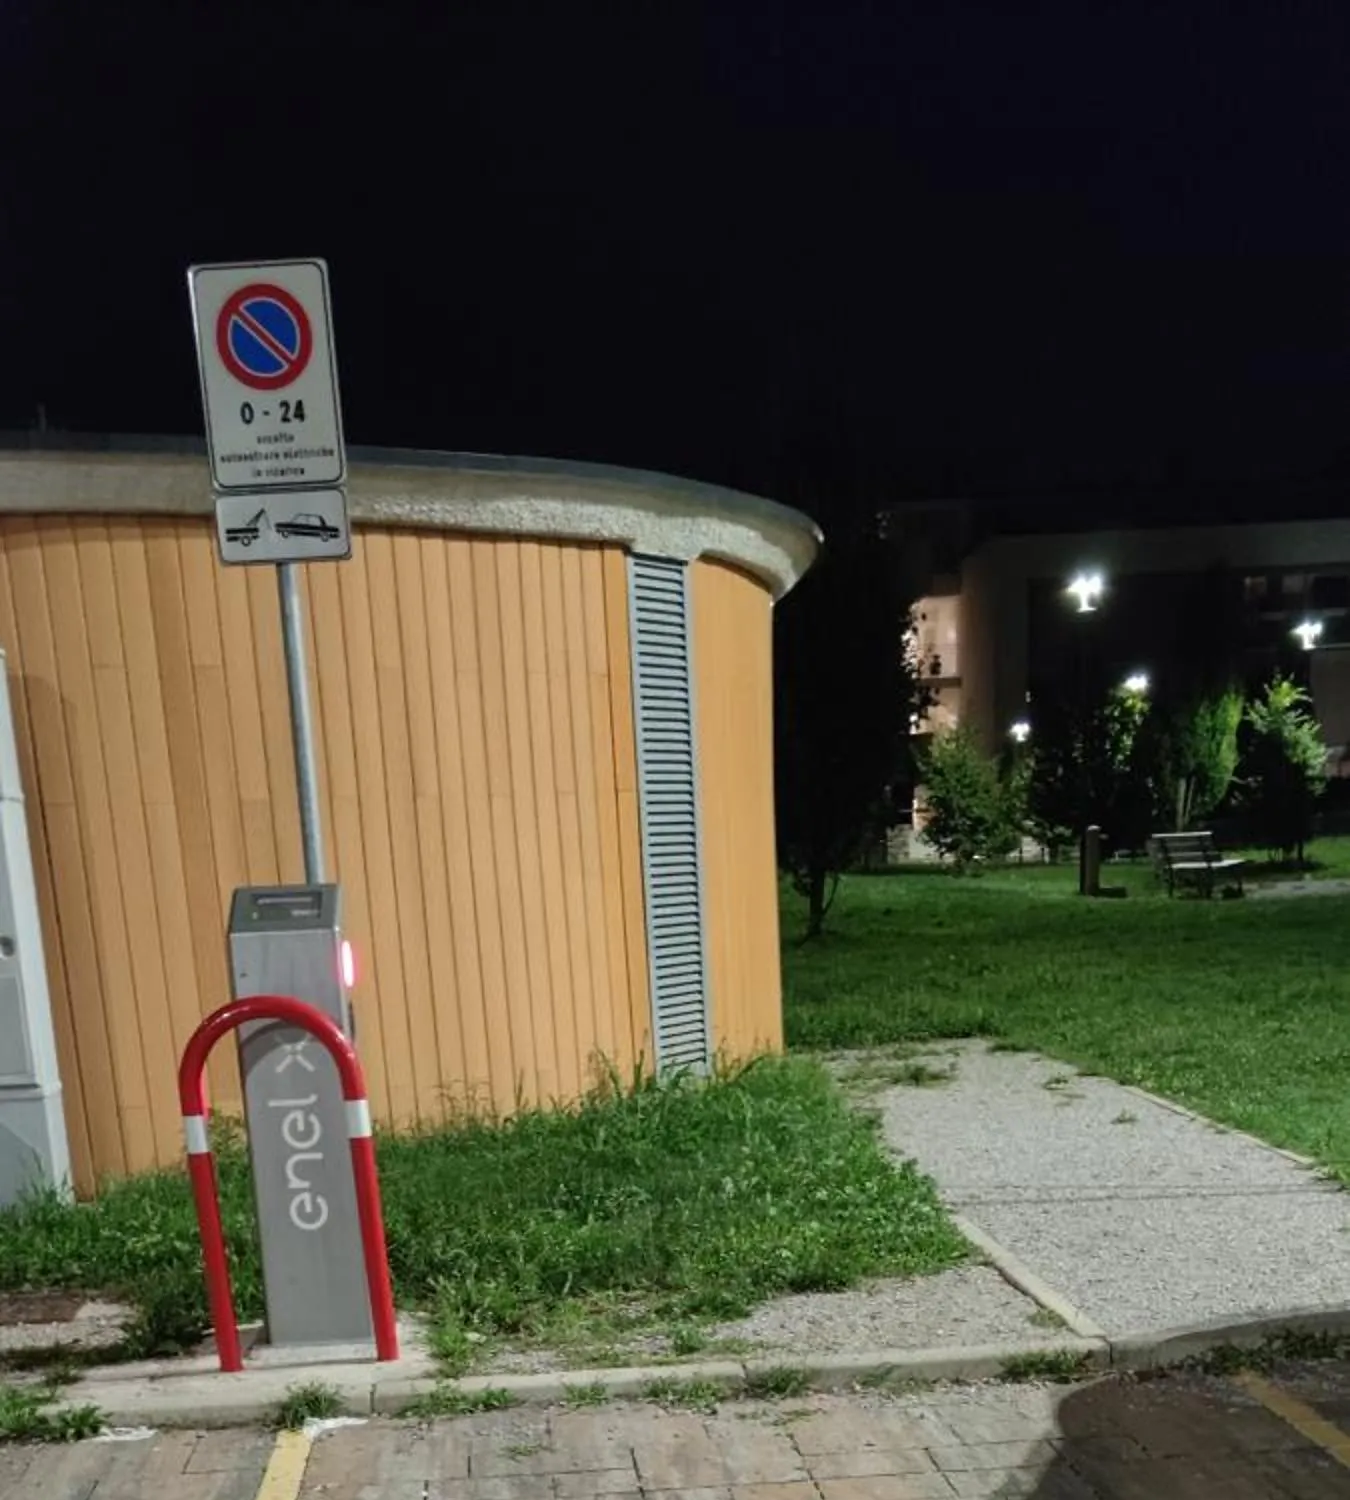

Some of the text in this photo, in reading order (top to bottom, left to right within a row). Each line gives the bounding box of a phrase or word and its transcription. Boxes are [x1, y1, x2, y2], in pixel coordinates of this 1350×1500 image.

[240, 401, 254, 424] 0
[279, 400, 305, 423] 24
[268, 1093, 329, 1231] enel
